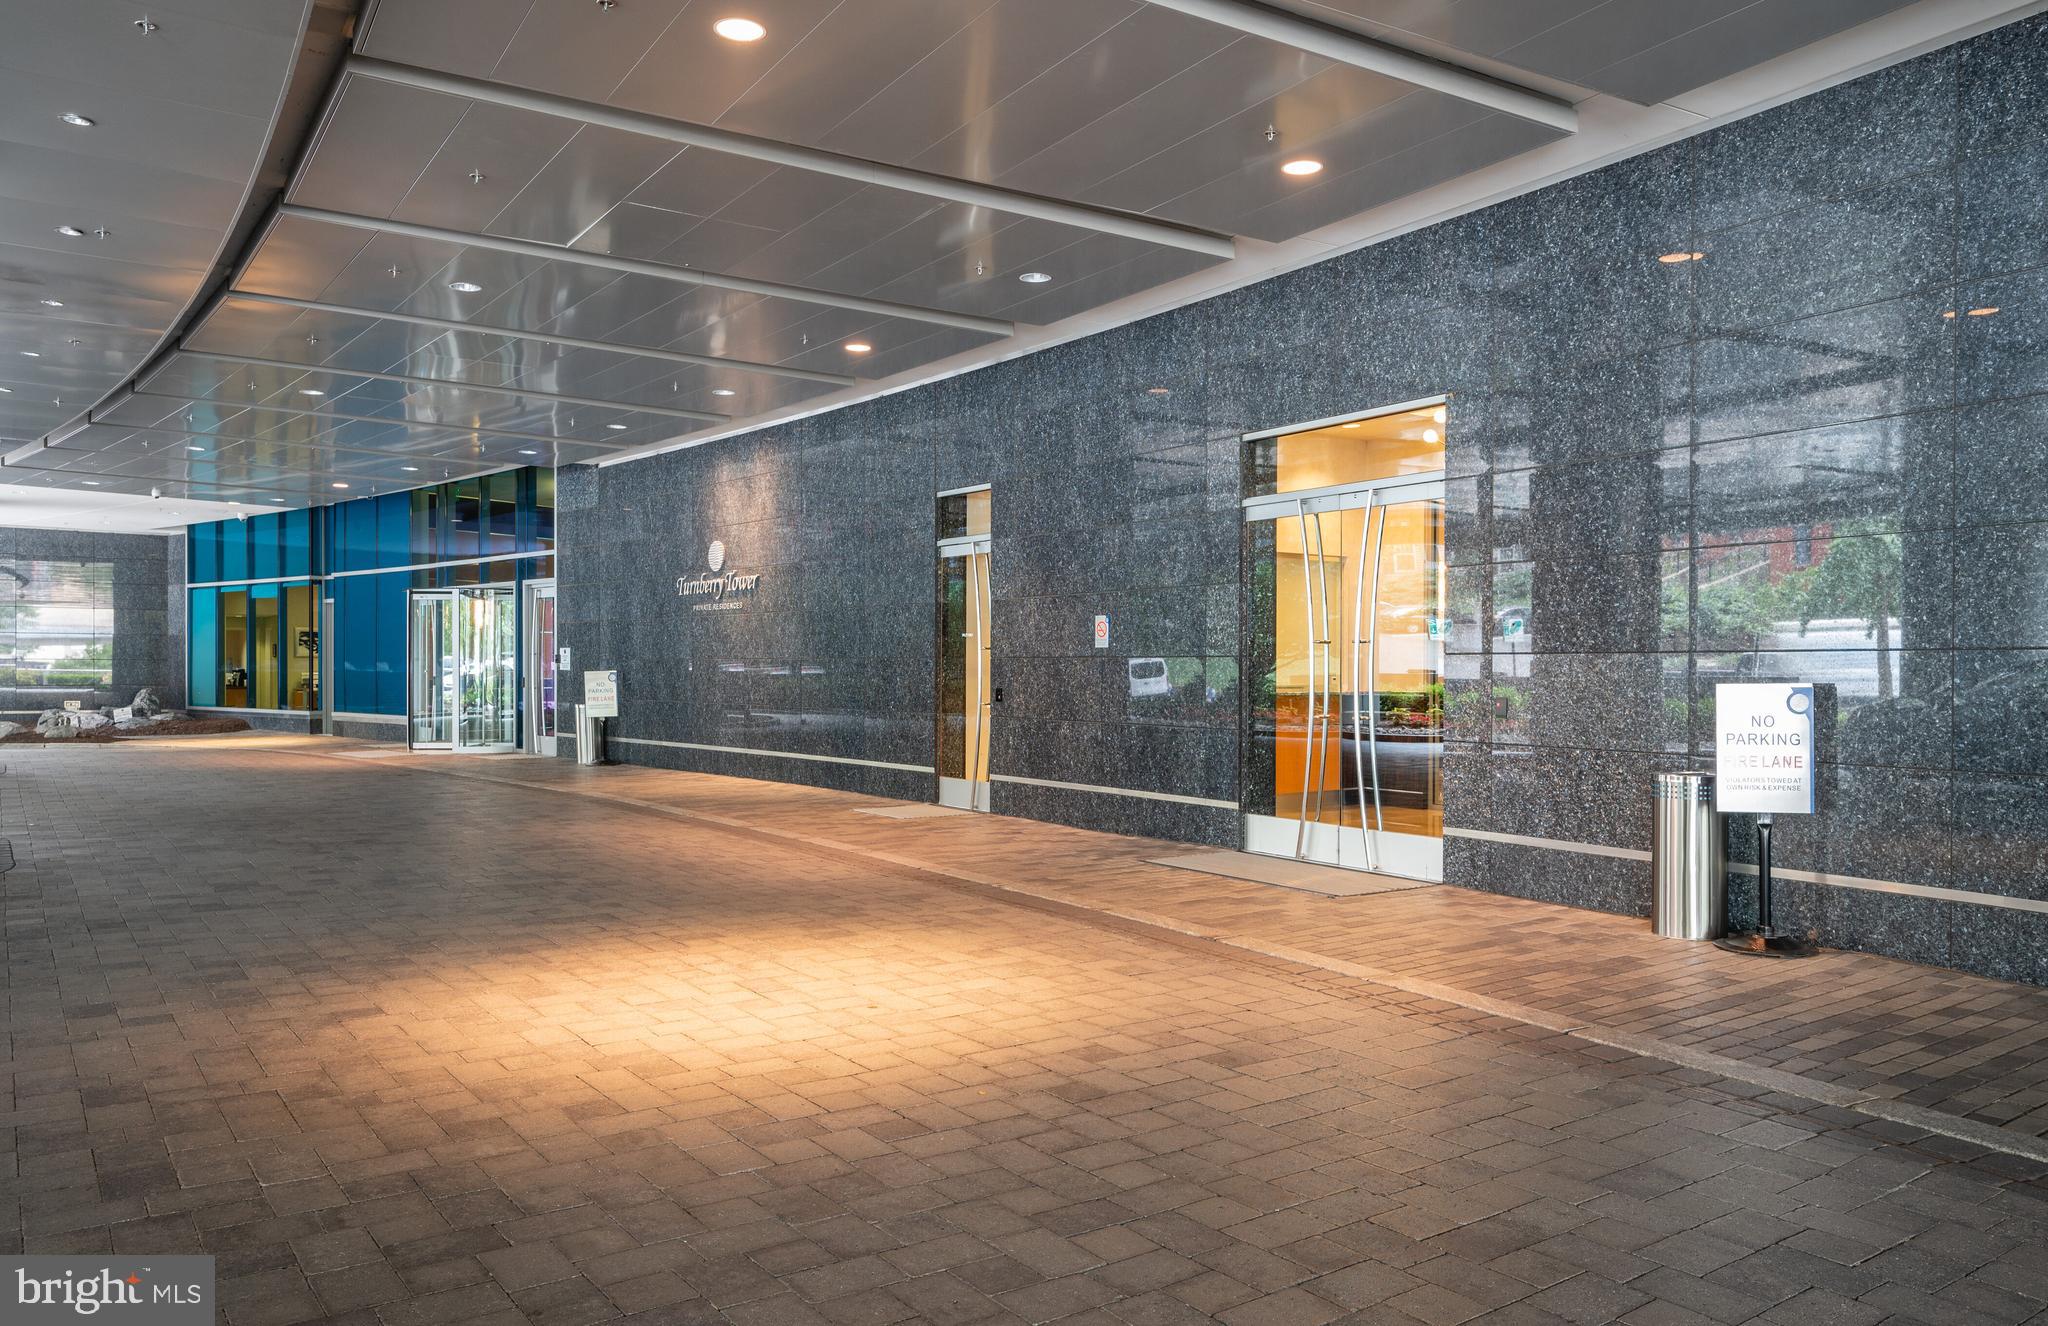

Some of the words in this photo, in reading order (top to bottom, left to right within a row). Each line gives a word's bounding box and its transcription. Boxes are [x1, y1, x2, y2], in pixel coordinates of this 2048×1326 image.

[725, 569, 760, 592] Tower
[1751, 715, 1775, 728] NO
[1726, 733, 1801, 746] PARKING
[1761, 755, 1804, 769] LANE
